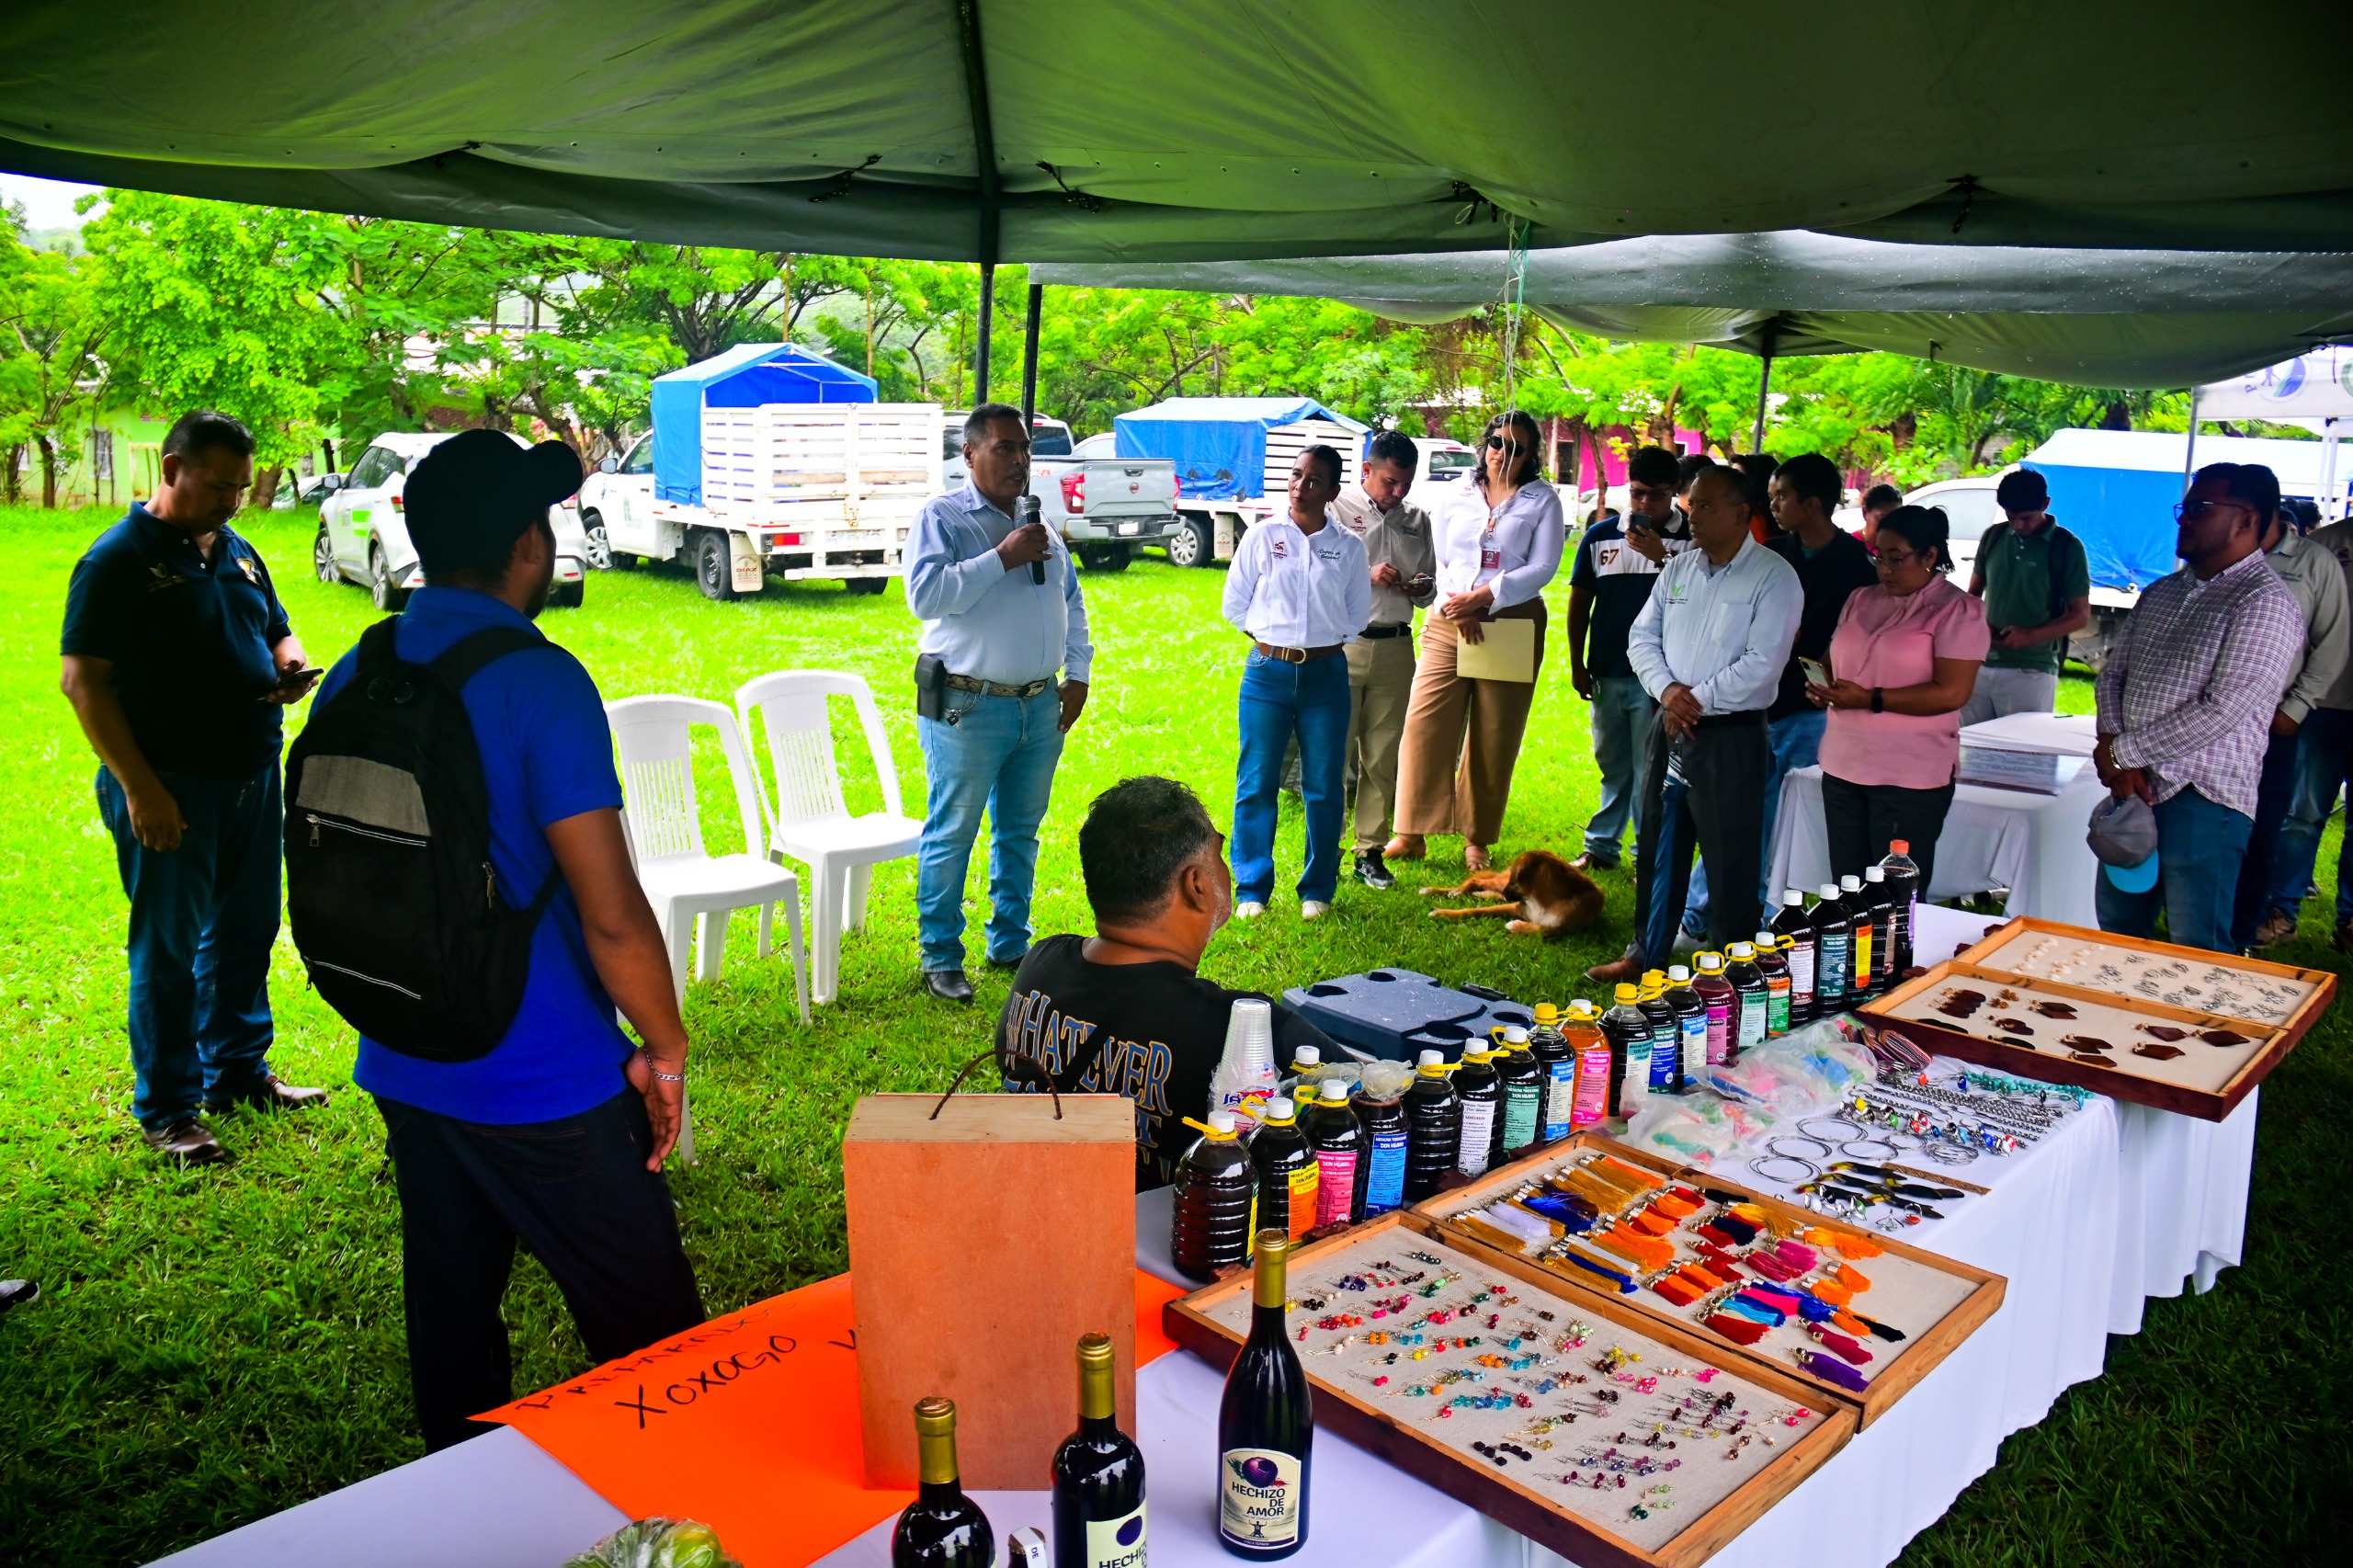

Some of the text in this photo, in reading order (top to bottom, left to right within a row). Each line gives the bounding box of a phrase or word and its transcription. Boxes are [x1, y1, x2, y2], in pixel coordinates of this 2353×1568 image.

[1600, 549, 1620, 566] 67
[614, 1335, 797, 1429] XOXOGO
[1232, 1481, 1286, 1499] HECHIZO
[1269, 1498, 1285, 1508] DE
[1246, 1506, 1285, 1517] AMOR
[1030, 1547, 1040, 1560] DE
